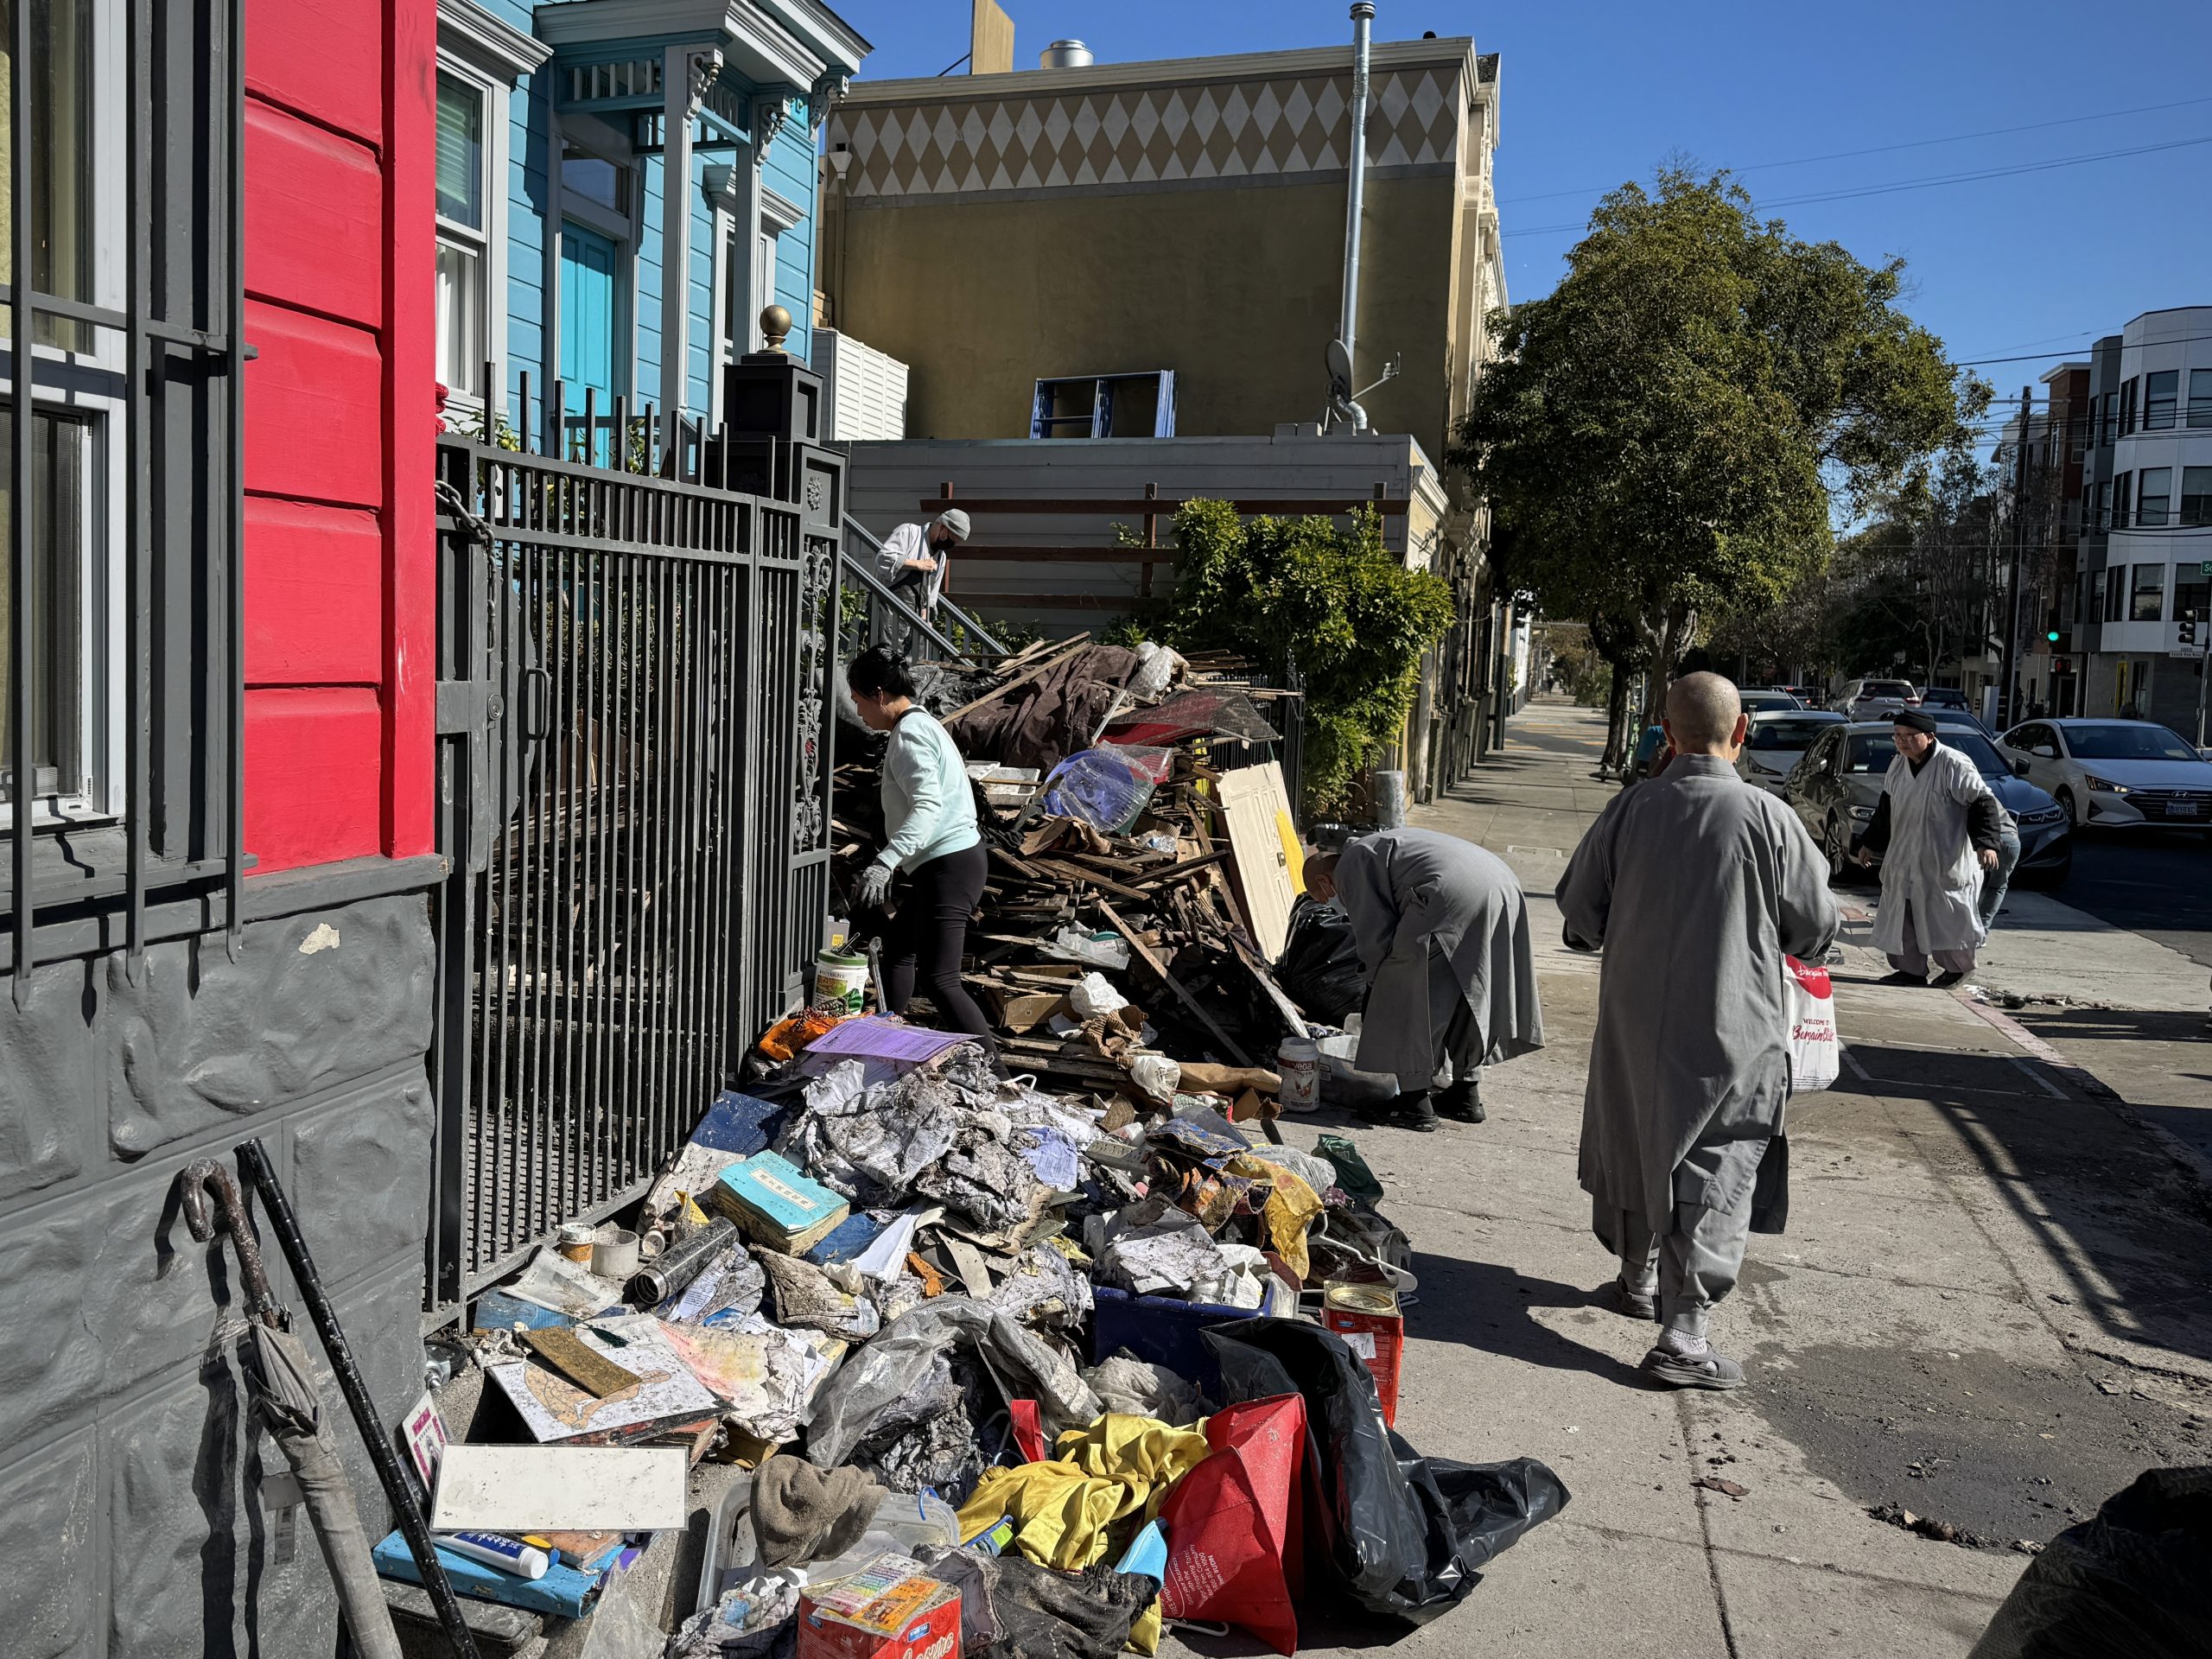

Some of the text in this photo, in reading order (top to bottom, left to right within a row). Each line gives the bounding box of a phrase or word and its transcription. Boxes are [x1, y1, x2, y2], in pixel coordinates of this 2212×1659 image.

[1173, 1557, 1183, 1581] business
[1190, 1544, 1203, 1572] Company
[1190, 1566, 1203, 1590] Shopping
